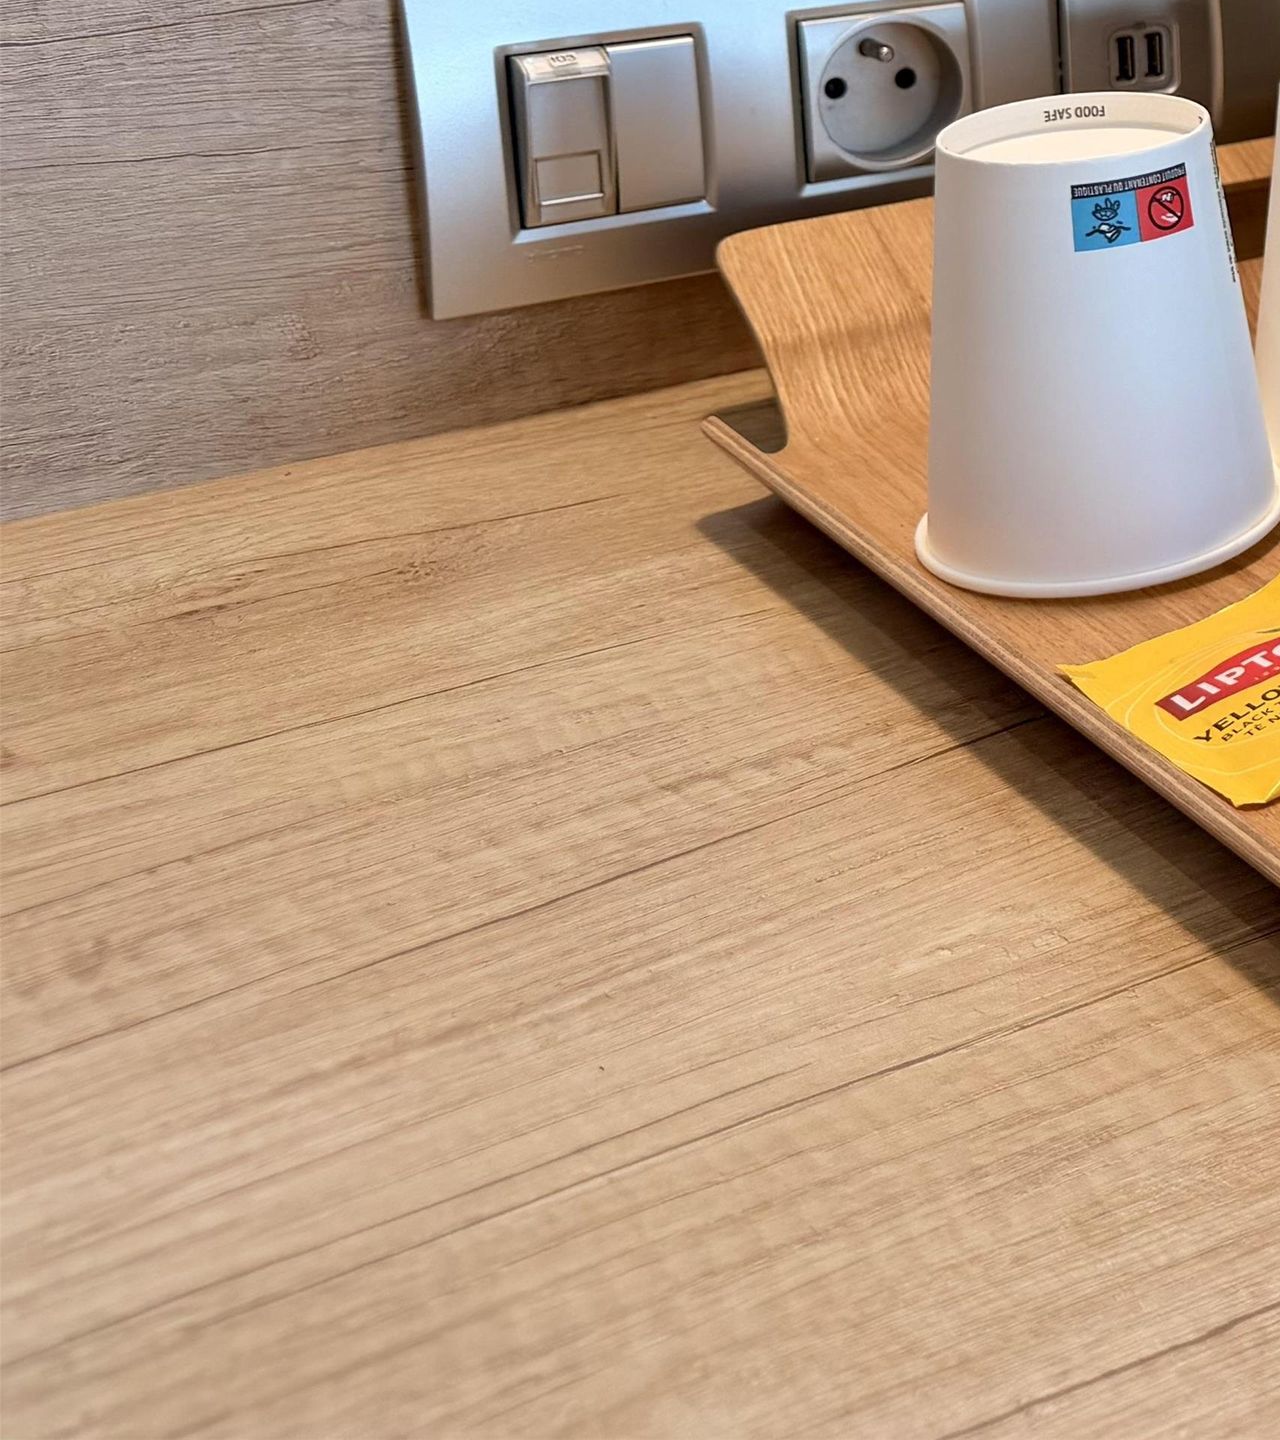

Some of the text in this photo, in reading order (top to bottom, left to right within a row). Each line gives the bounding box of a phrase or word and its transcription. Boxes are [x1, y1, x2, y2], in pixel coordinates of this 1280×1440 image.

[1043, 105, 1106, 123] FOOD SAFE
[1159, 163, 1187, 184] PRODUIT
[1073, 182, 1112, 198] PLASTIQUE
[1221, 707, 1275, 742] BLACK
